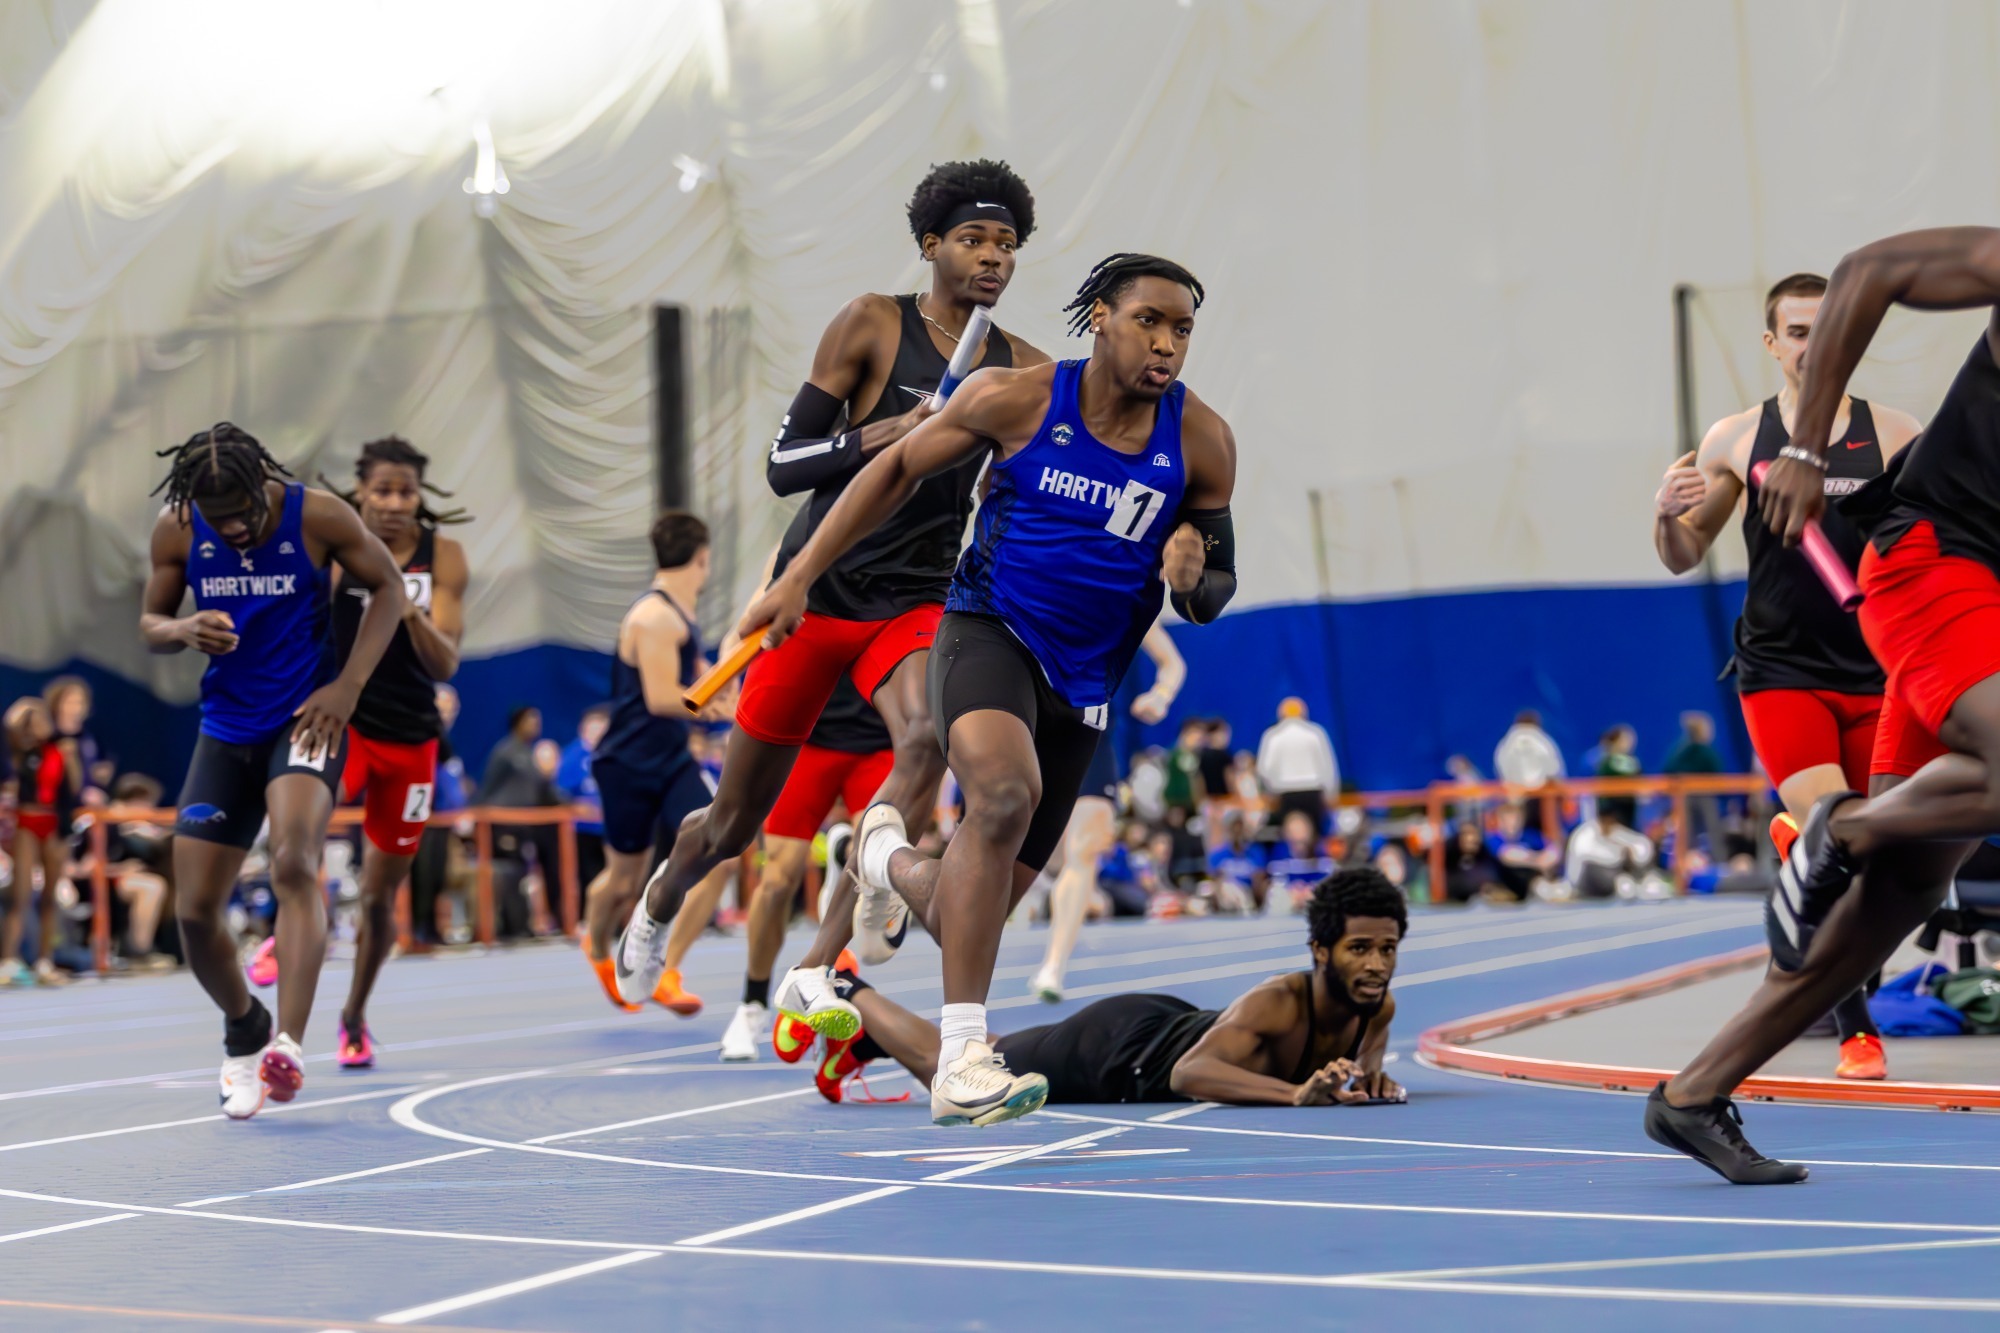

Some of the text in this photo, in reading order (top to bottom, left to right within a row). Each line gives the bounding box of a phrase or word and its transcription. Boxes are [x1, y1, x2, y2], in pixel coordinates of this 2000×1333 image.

[1038, 466, 1123, 509] HARTW
[1124, 491, 1153, 537] 1
[201, 574, 296, 597] HARTWICK
[410, 788, 426, 818] 2
